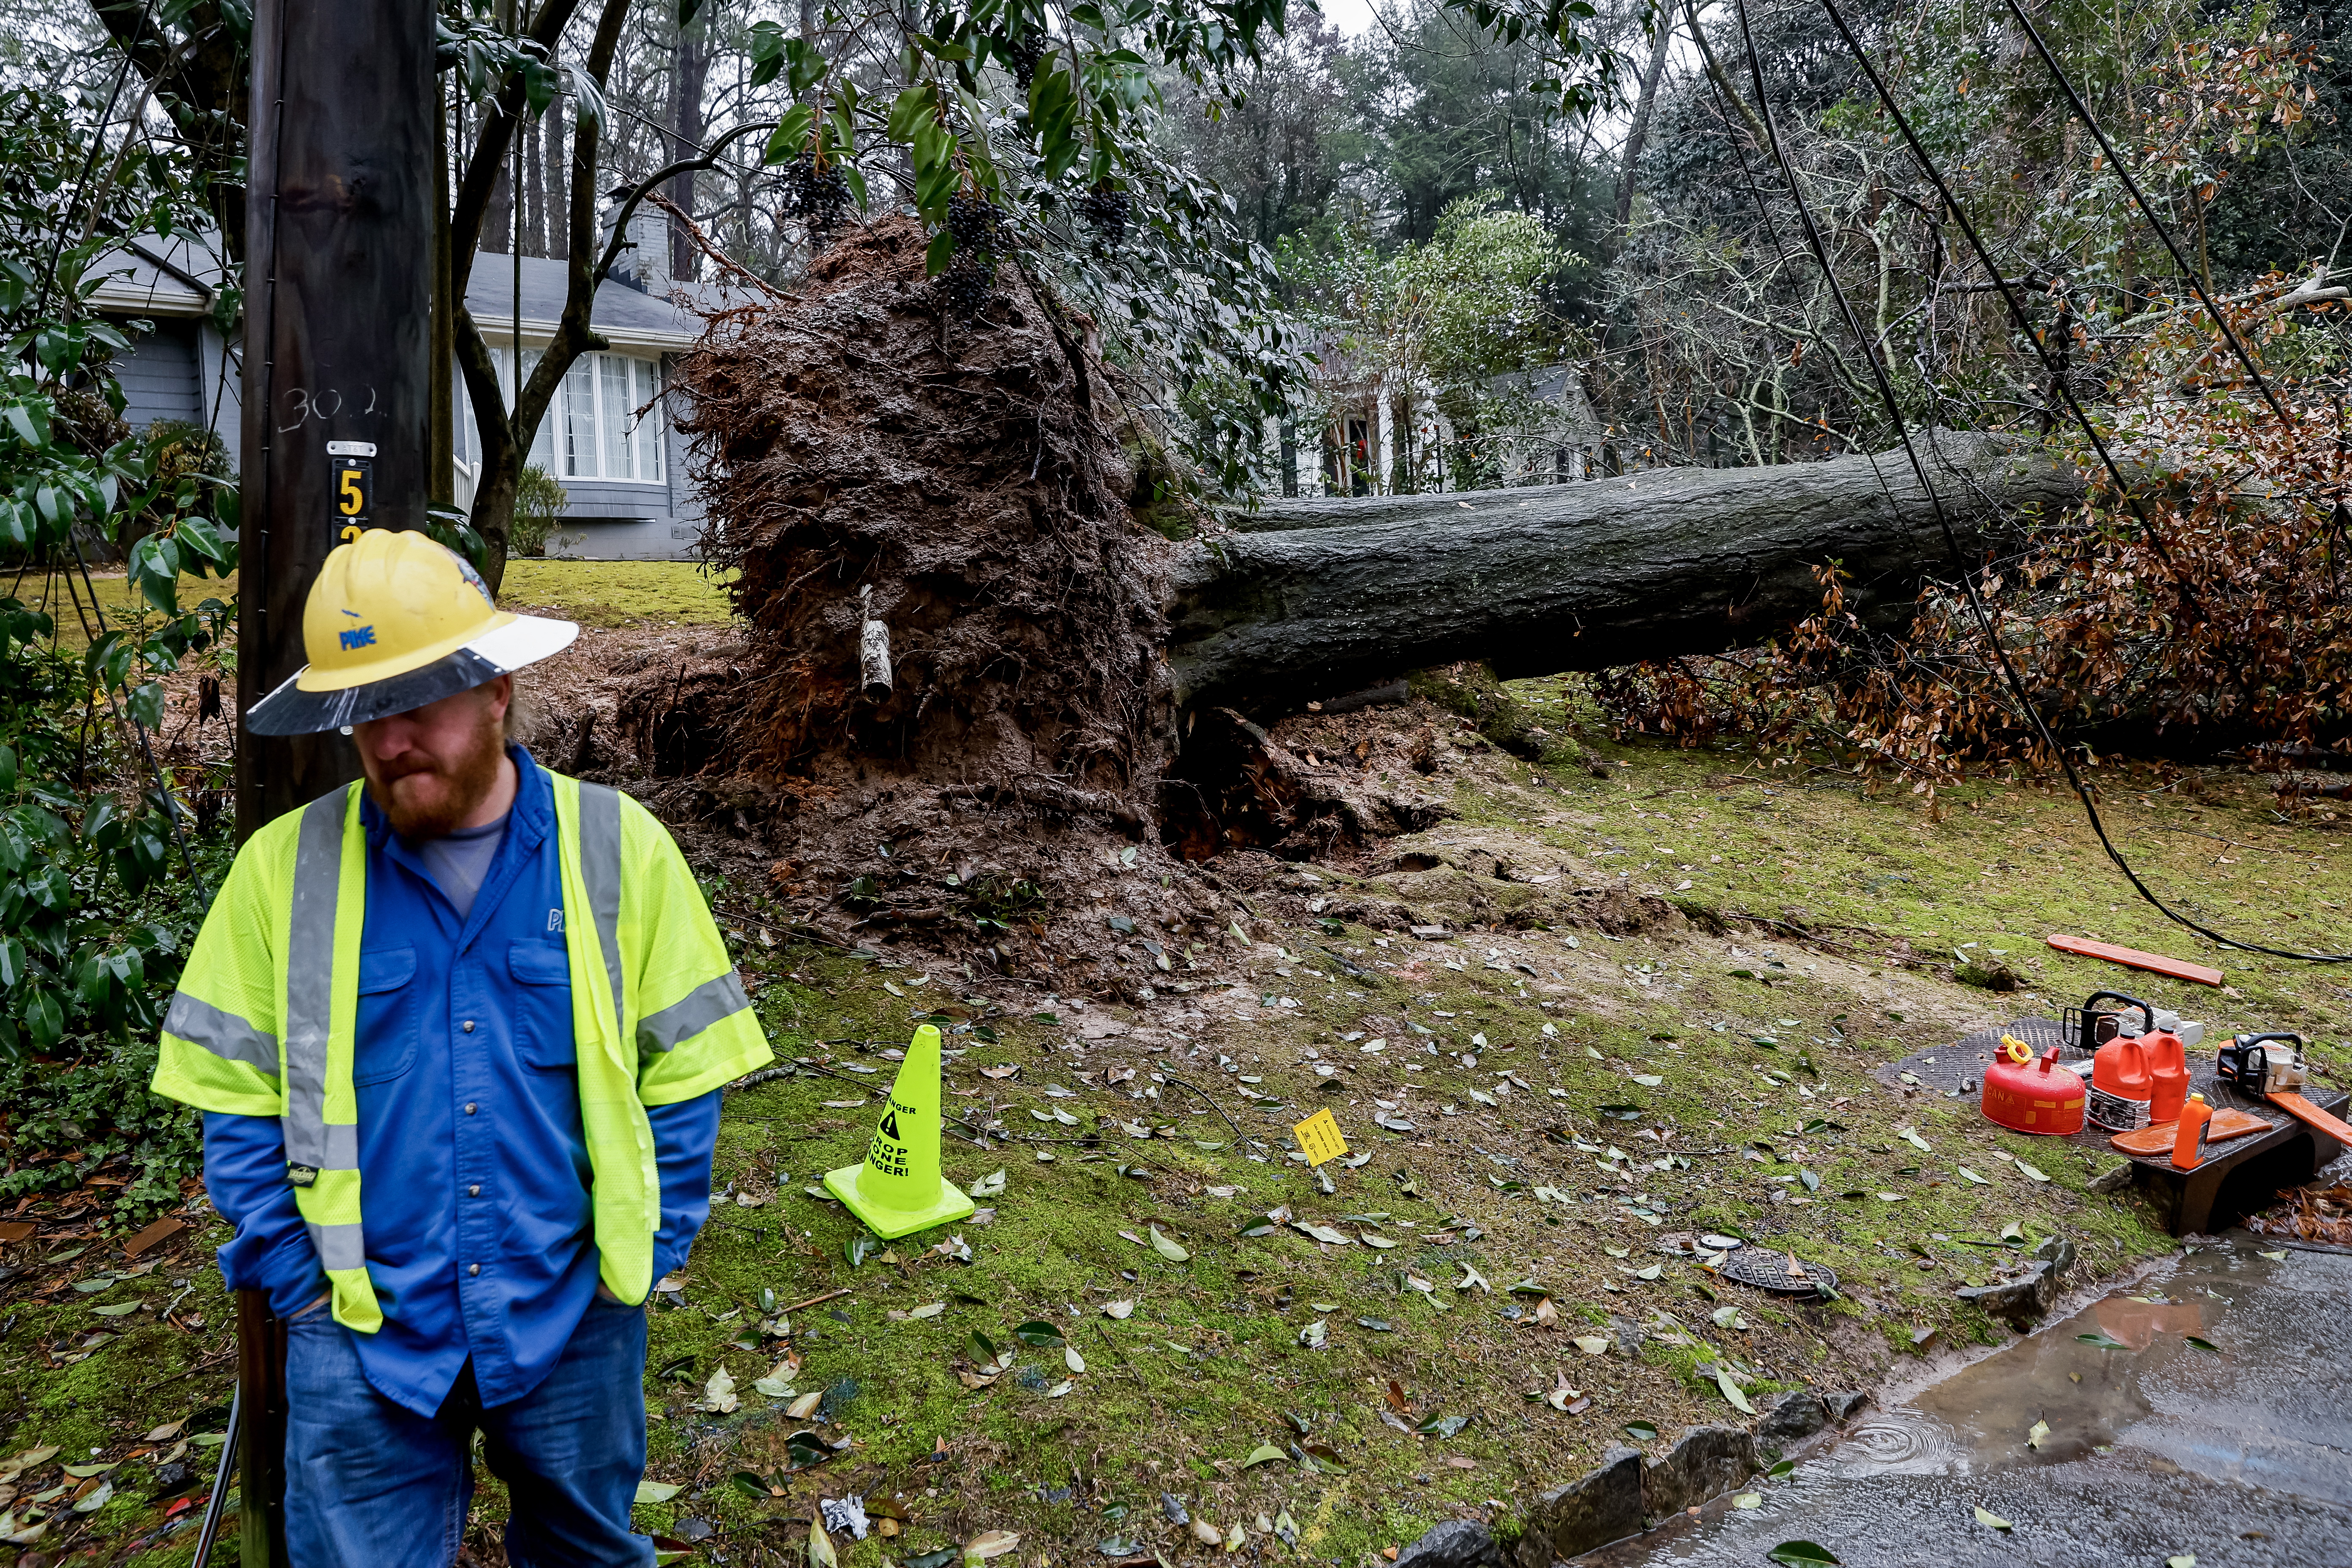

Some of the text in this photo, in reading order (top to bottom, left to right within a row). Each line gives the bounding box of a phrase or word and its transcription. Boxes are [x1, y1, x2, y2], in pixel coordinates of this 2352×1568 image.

[342, 443, 364, 452] AT&T
[339, 625, 377, 651] PIKE
[1988, 1086, 2004, 1101] CAN
[889, 1096, 916, 1114] ANGER
[873, 1133, 908, 1155] ROP
[873, 1143, 906, 1165] ONE
[868, 1148, 909, 1177] ANGER!
